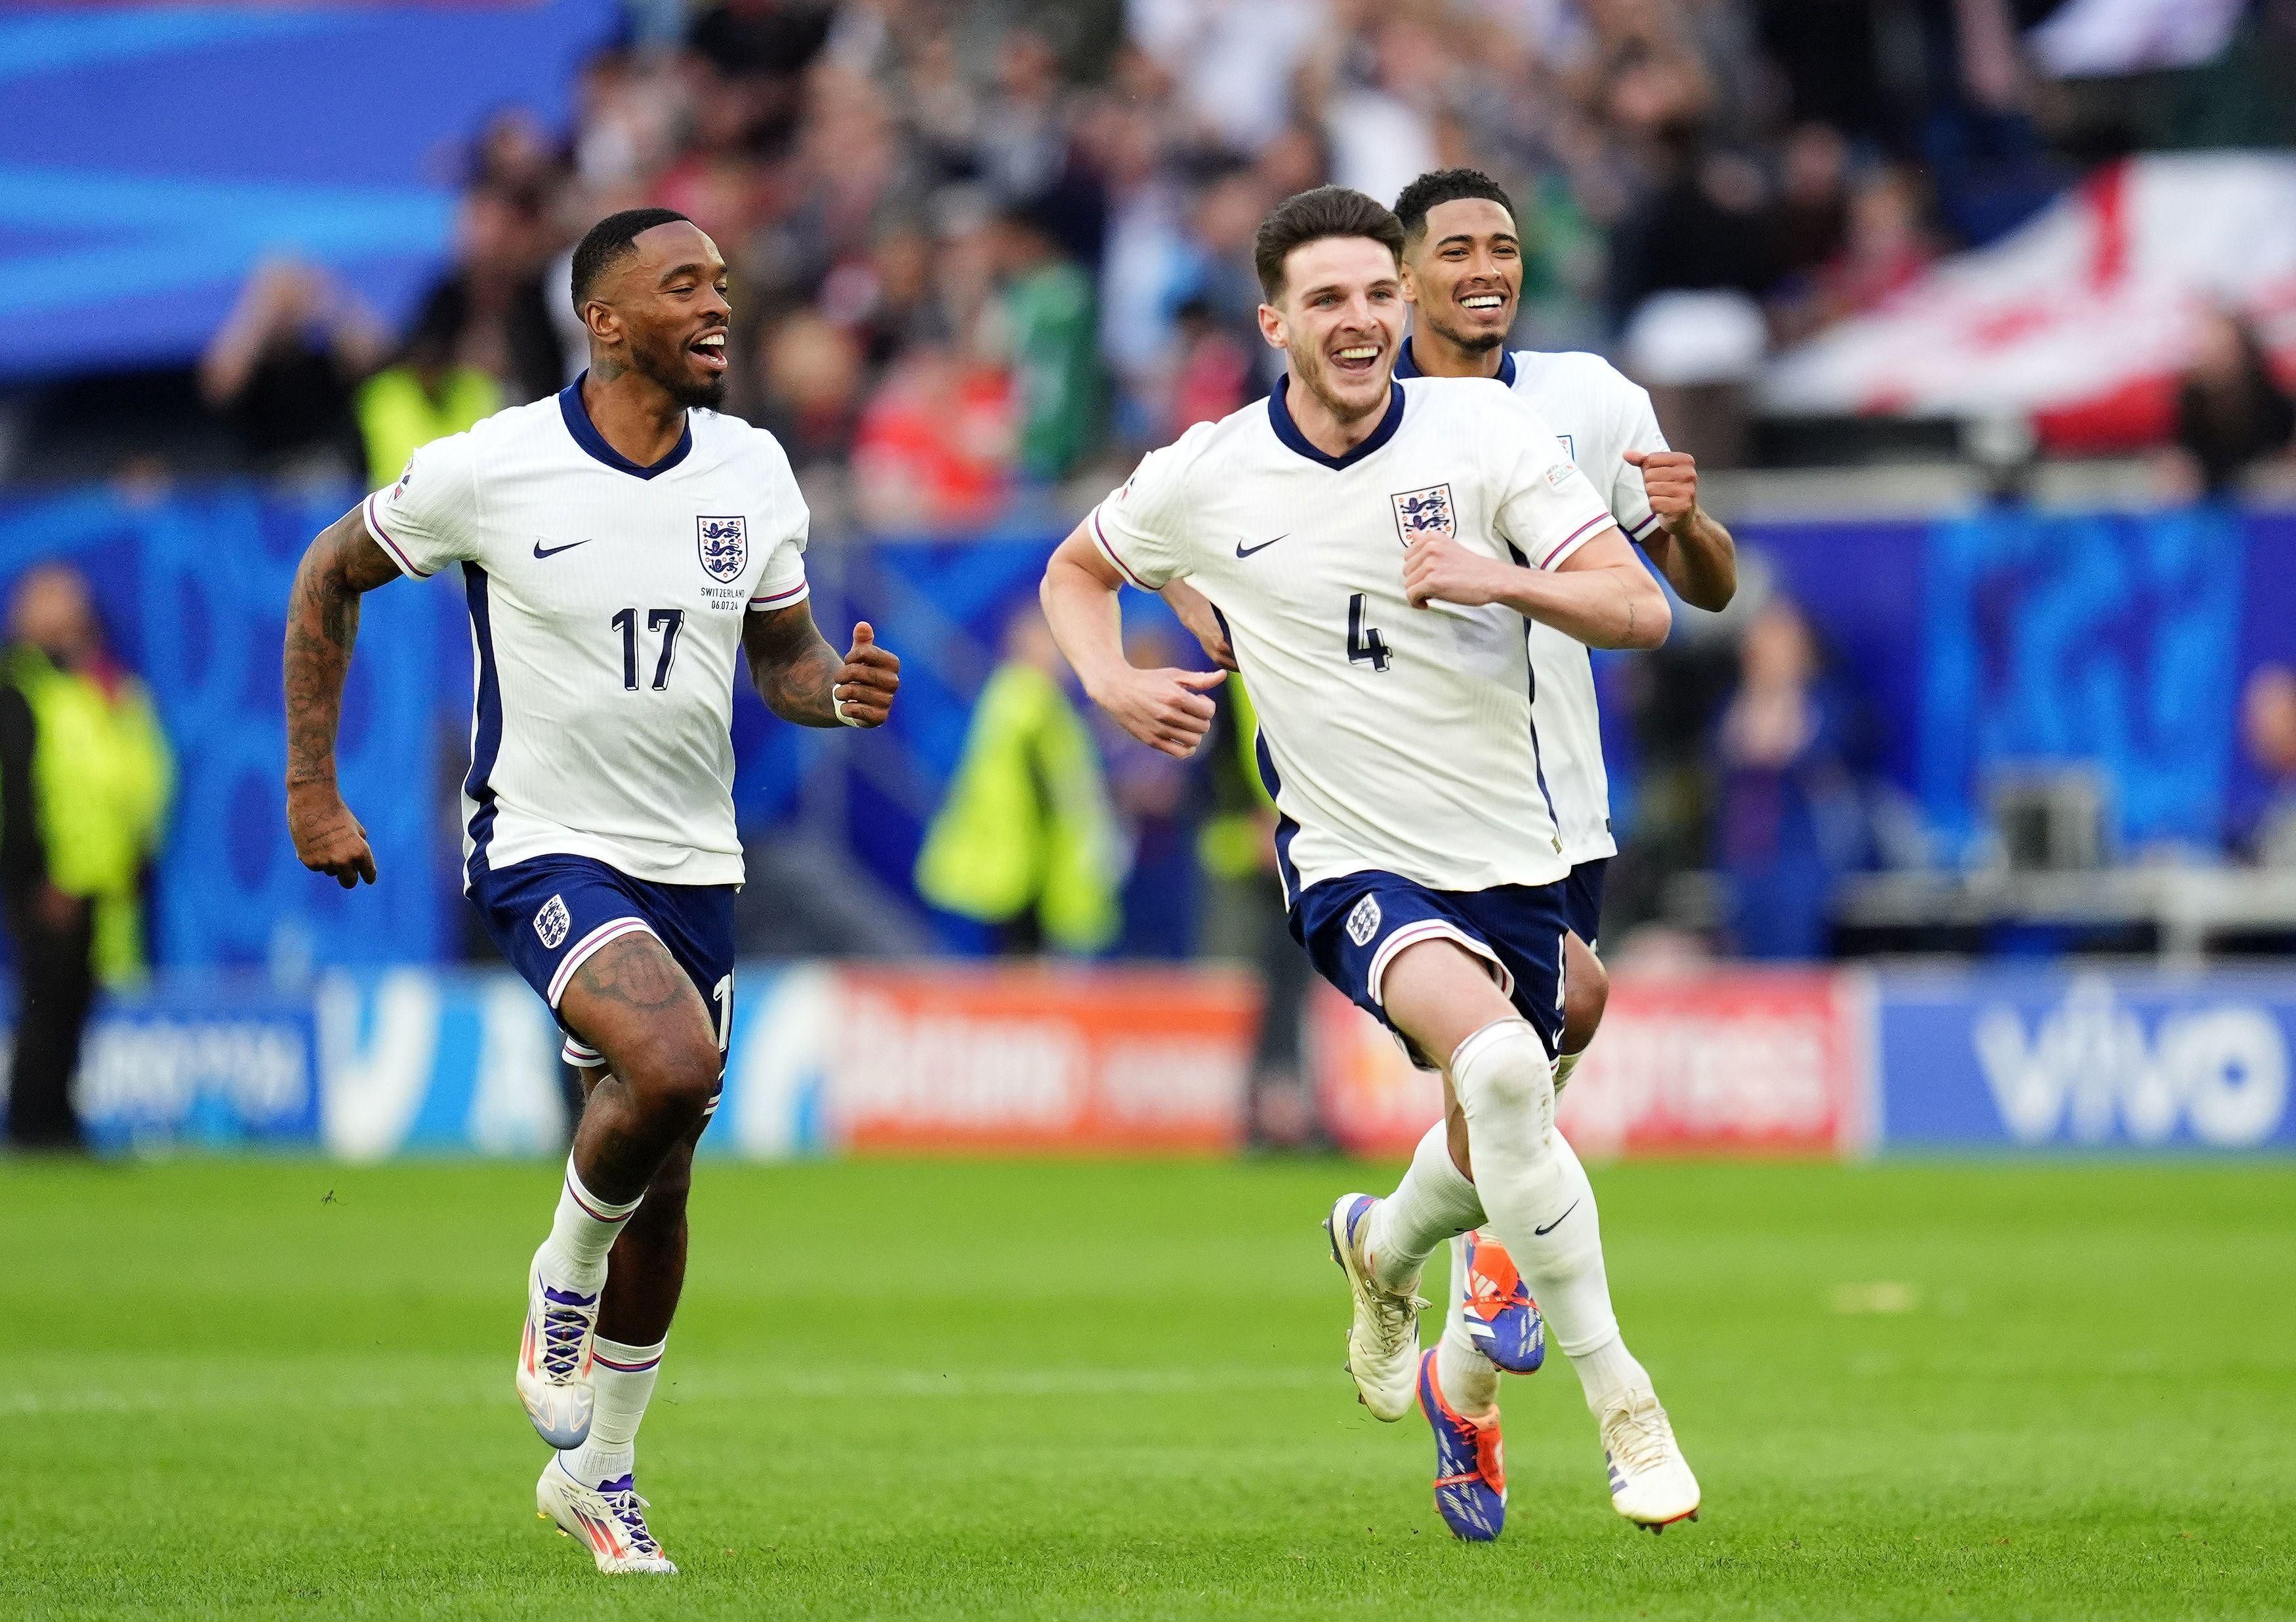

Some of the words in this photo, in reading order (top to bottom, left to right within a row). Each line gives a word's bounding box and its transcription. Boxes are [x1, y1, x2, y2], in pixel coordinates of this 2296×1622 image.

[701, 587, 745, 598] SWITZERLAND
[711, 600, 738, 610] 06.07.24
[1347, 593, 1393, 673] 4
[612, 608, 684, 691] 17
[713, 967, 735, 1053] 1
[1973, 974, 2289, 1145] vivo
